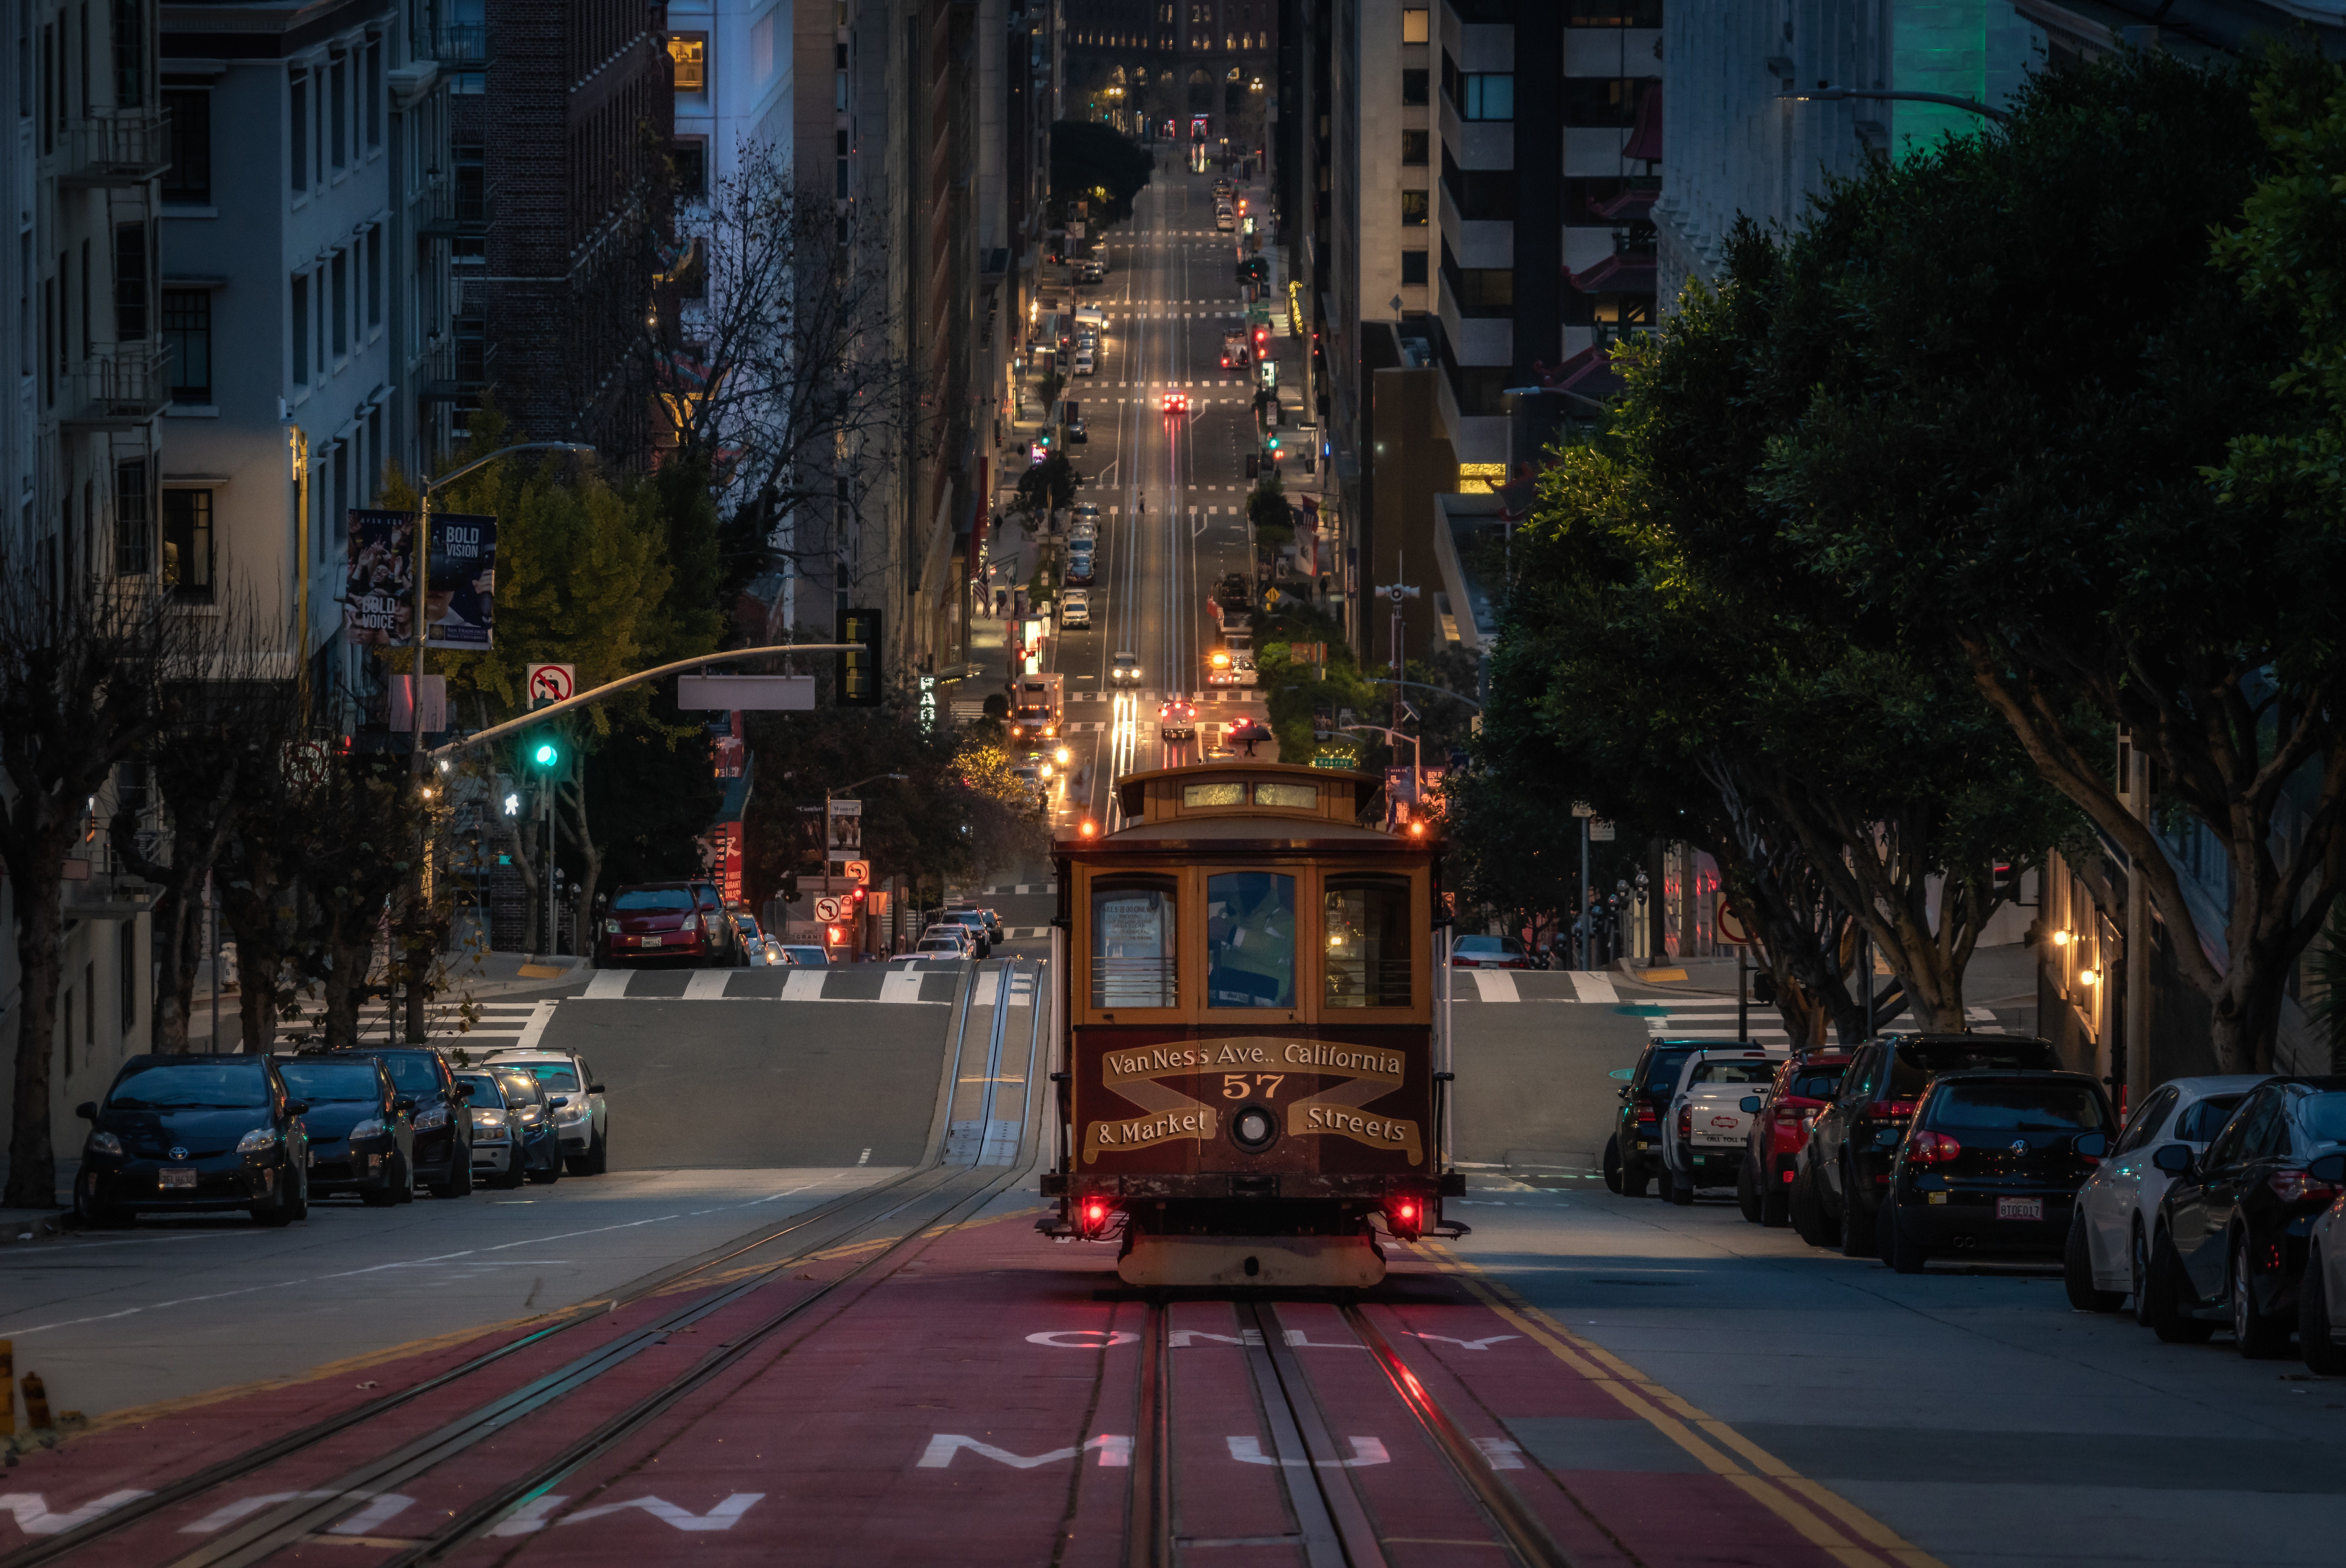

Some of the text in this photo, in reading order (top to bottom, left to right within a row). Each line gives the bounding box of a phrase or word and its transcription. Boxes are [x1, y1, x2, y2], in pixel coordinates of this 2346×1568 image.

[446, 525, 480, 543] BOLD
[446, 543, 479, 558] VISION
[362, 596, 396, 613] BOLD
[362, 613, 395, 629] VOICE
[1284, 1044, 1401, 1075] California
[1222, 1074, 1285, 1099] 57
[1099, 1108, 1406, 1144] & Market Streets
[1025, 1330, 1523, 1350] ONLY
